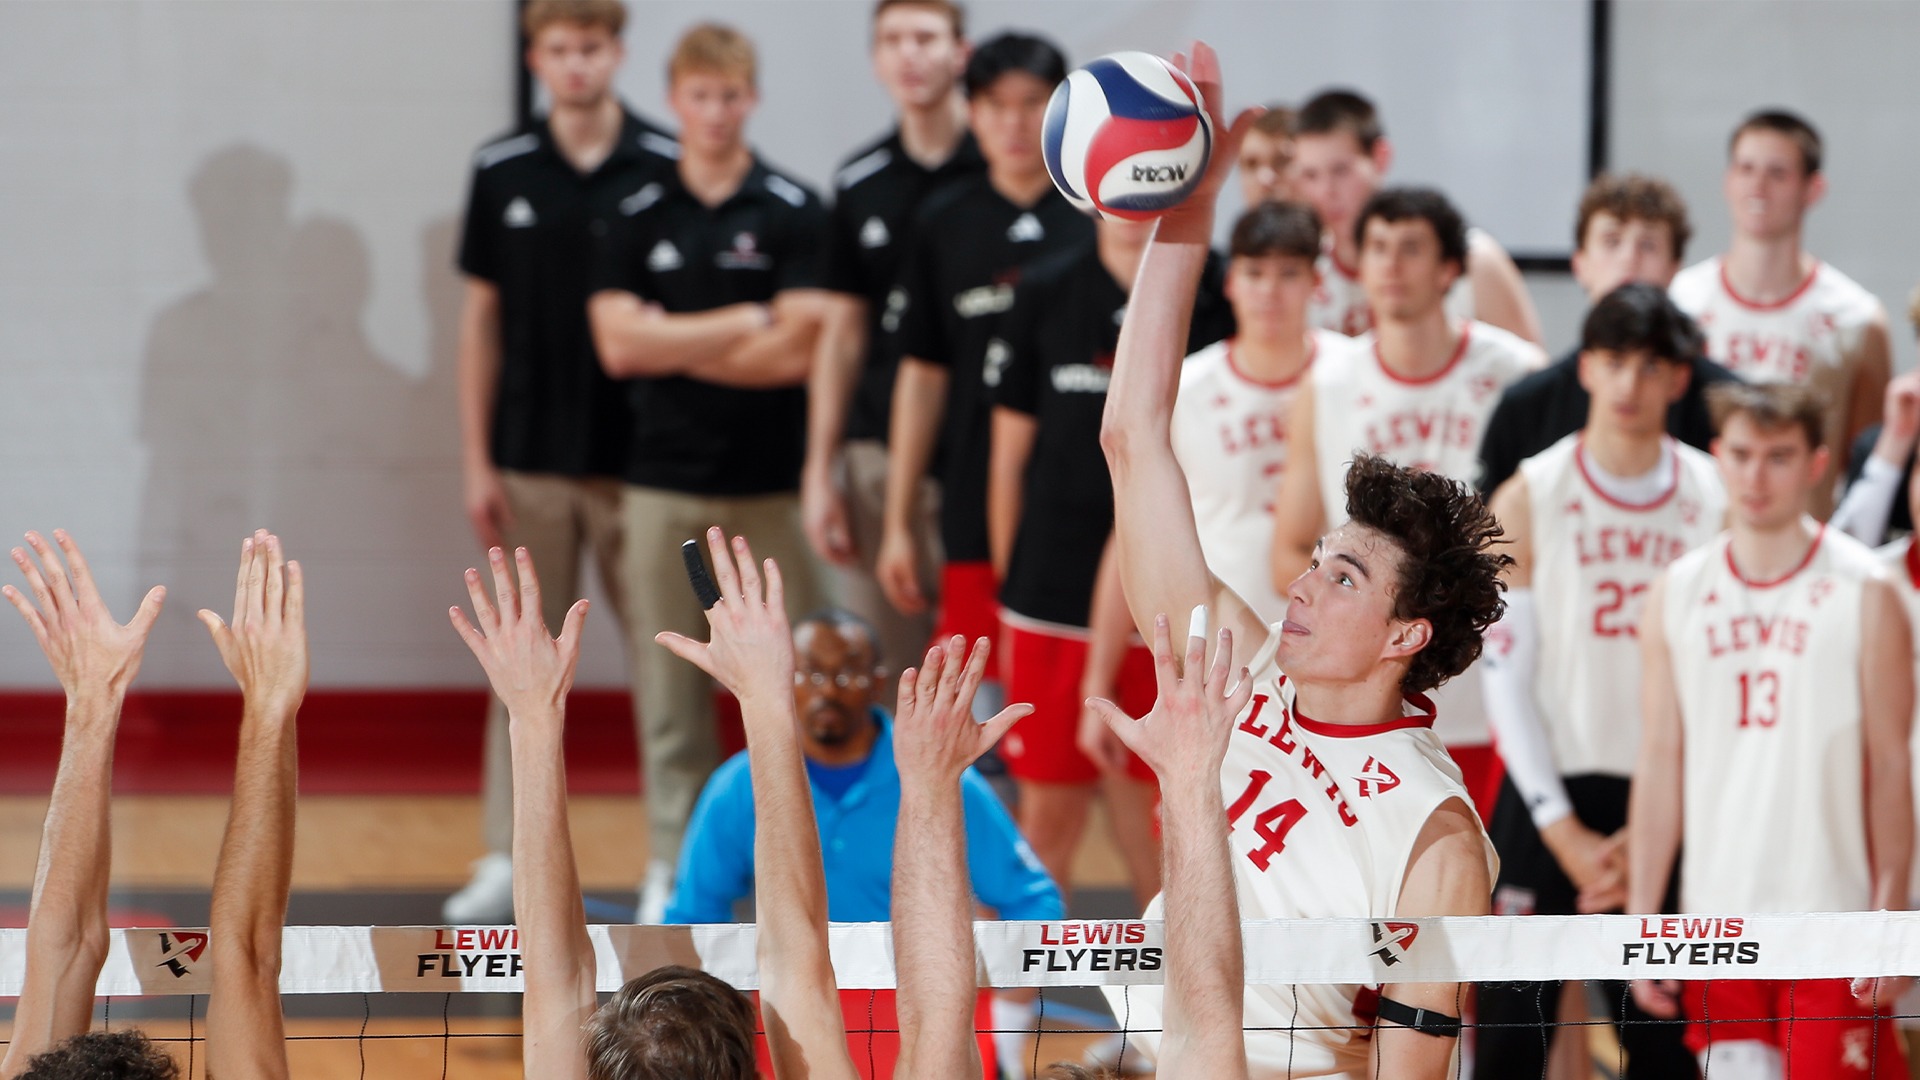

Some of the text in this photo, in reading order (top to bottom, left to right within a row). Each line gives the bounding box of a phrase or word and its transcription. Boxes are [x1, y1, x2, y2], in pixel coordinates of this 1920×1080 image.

[1366, 410, 1473, 453] LEWIS
[1575, 526, 1686, 568] LEWIS
[1706, 615, 1811, 657] LEWIS
[1737, 670, 1781, 729] 13
[1226, 769, 1308, 873] 14
[1041, 923, 1146, 945] LEWIS
[1640, 917, 1744, 938] LEWIS
[1022, 947, 1163, 972] FLYERS
[1622, 941, 1760, 965] FLYERS
